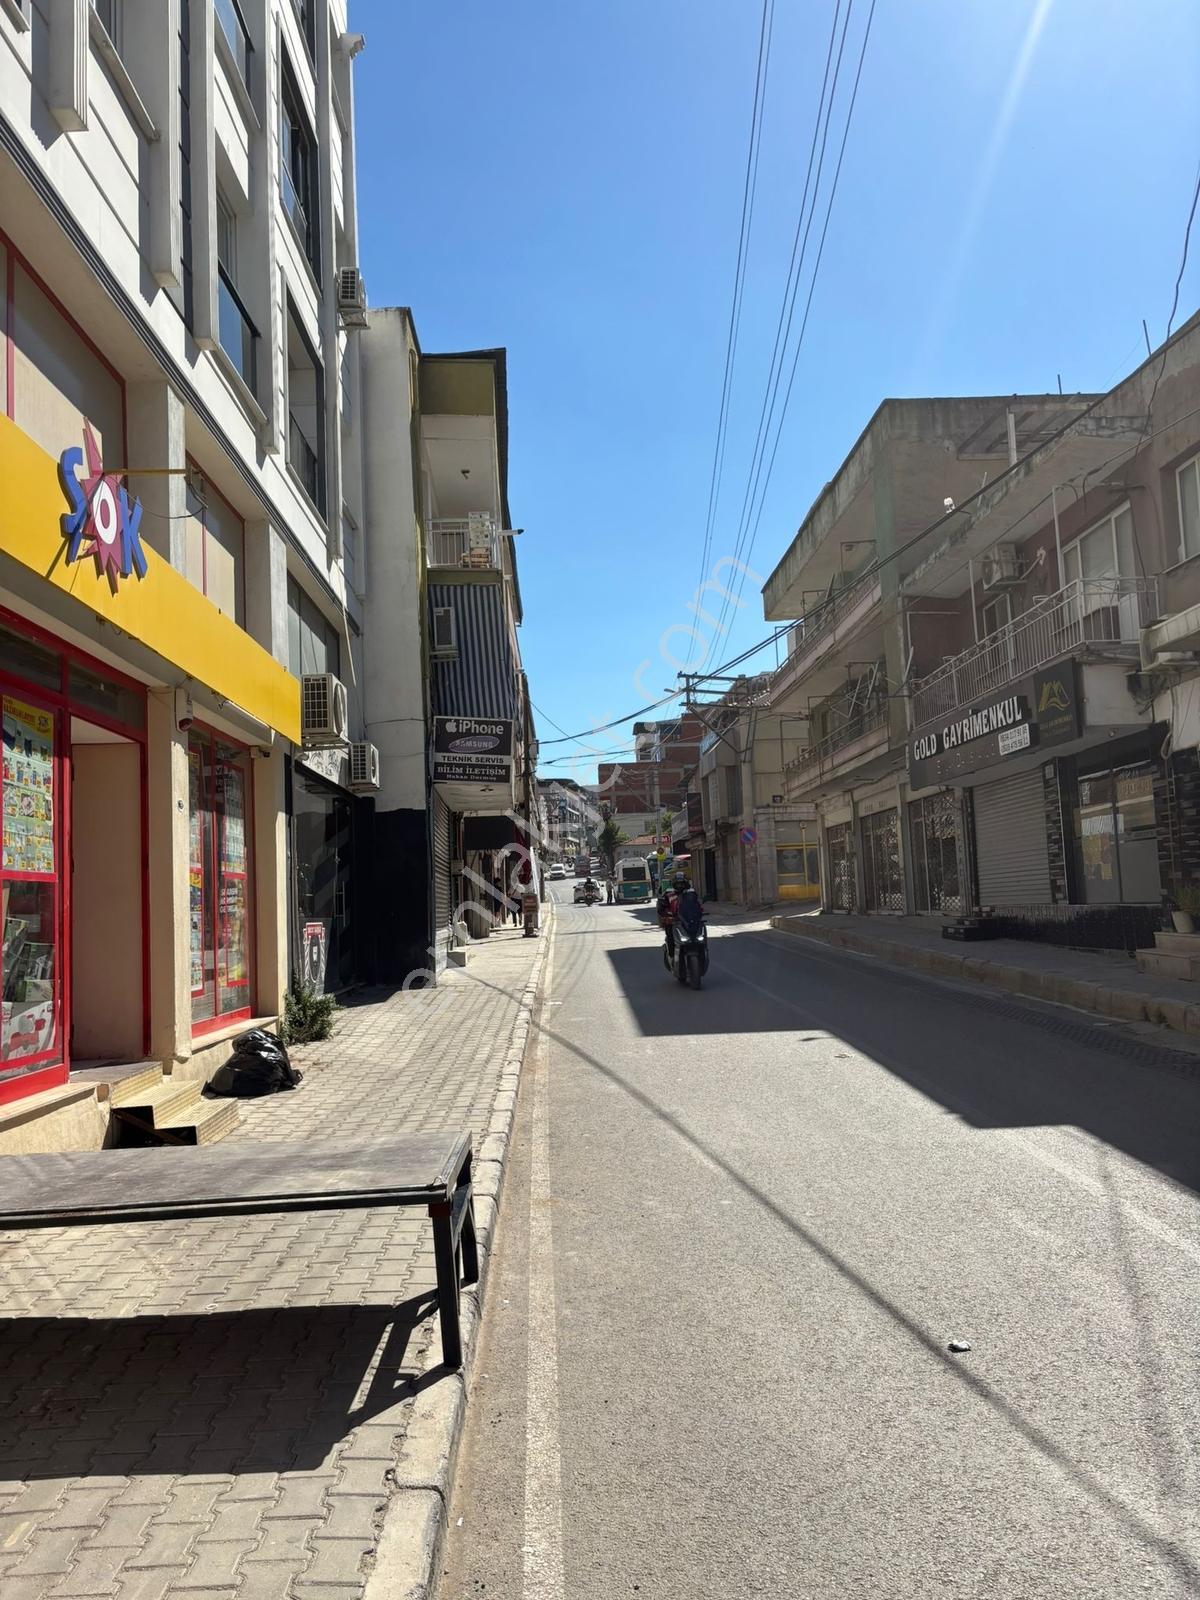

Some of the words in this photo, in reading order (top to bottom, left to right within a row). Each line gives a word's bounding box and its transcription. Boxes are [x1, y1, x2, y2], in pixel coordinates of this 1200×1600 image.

[459, 719, 504, 735] iPhone
[914, 733, 937, 760] GOLD
[943, 696, 1022, 750] GAYRİMENKUL
[455, 740, 493, 748] SAMSUNG
[441, 755, 473, 763] TEKNİK
[475, 756, 504, 764] SERVİS
[437, 764, 464, 774] BİLİM
[466, 765, 506, 777] İLETİŞİM
